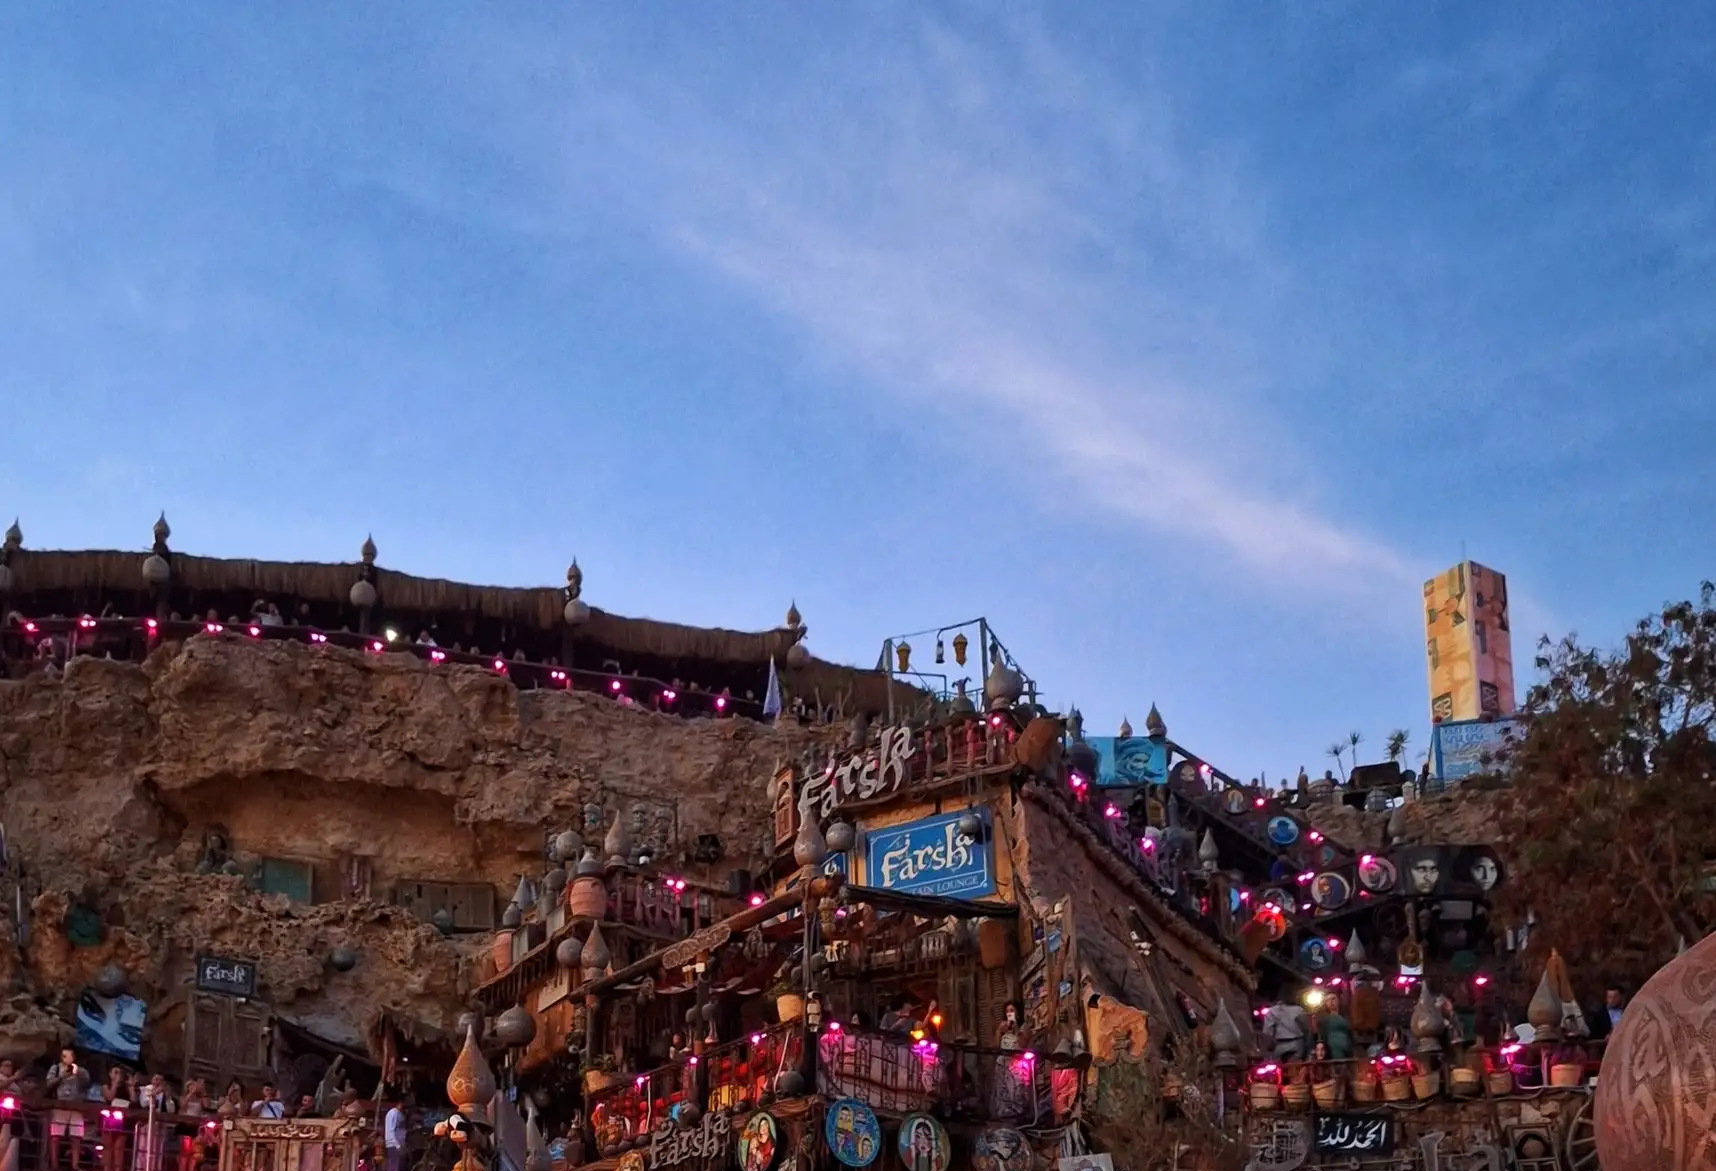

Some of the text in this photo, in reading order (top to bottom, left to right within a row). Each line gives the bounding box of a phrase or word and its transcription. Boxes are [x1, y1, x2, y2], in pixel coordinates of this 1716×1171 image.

[798, 726, 916, 831] Farsha
[881, 822, 976, 888] Farsha
[936, 875, 979, 893] LOUNGE
[648, 1111, 731, 1169] Farsha
